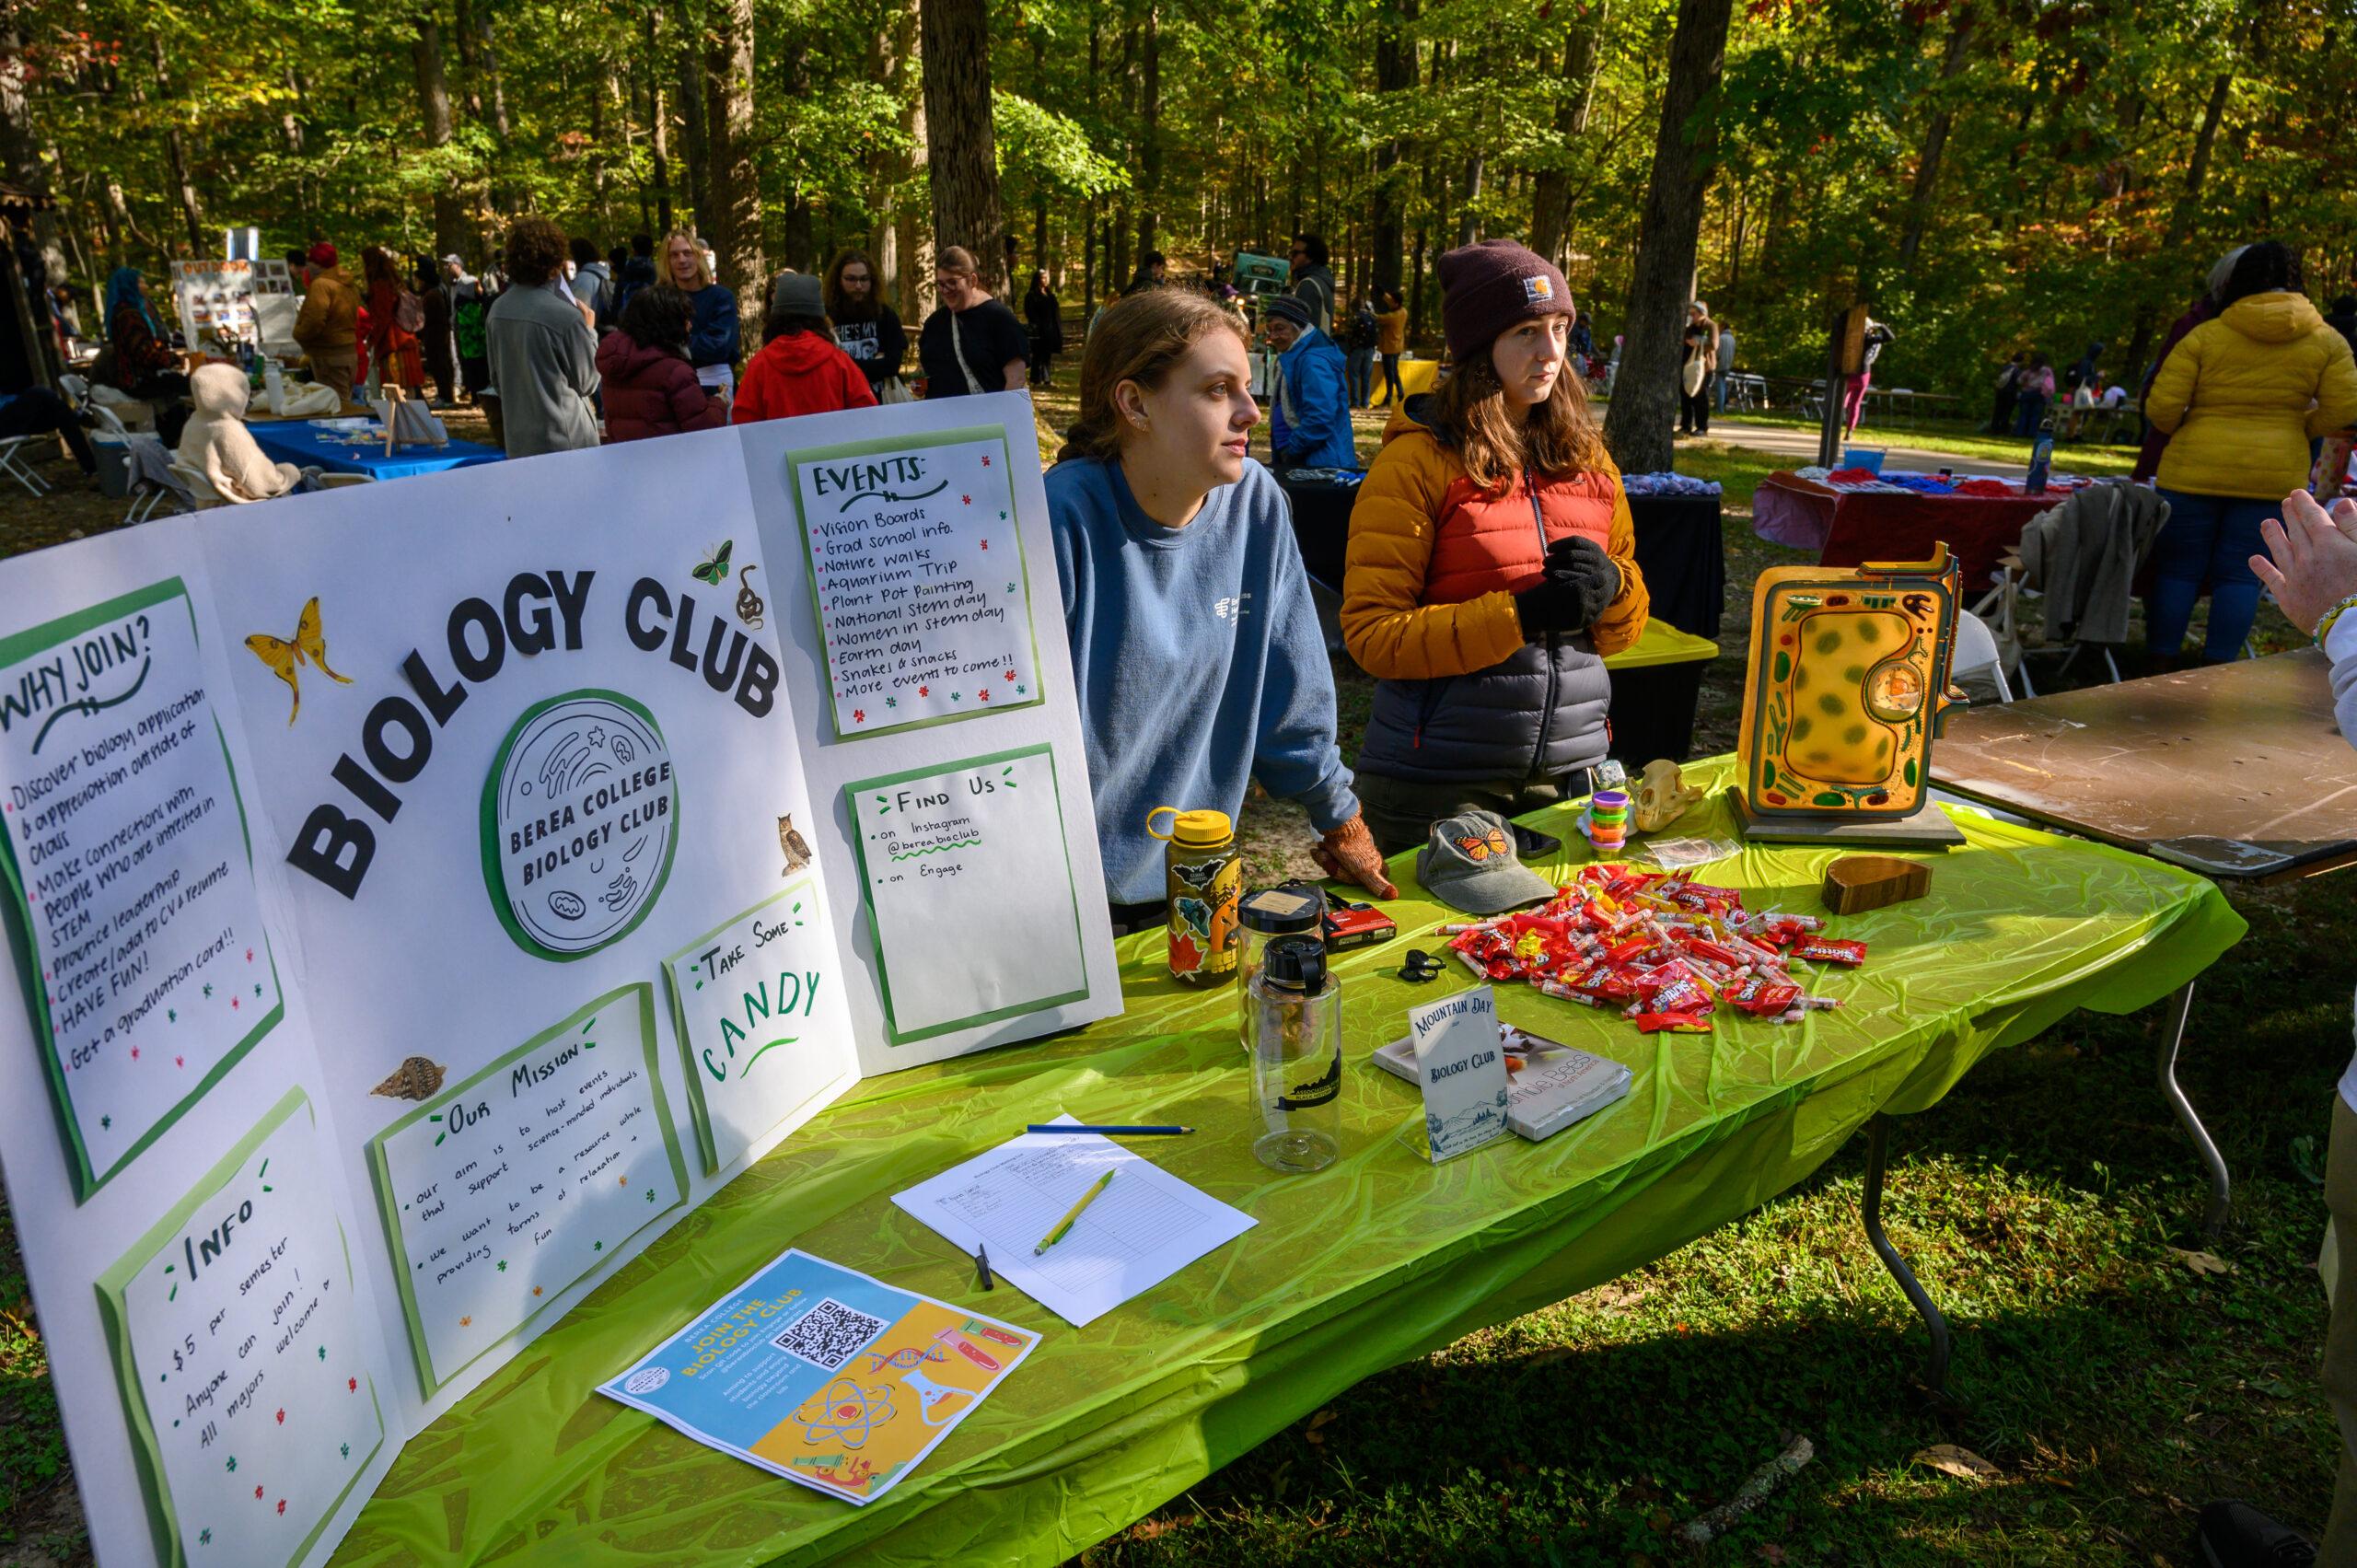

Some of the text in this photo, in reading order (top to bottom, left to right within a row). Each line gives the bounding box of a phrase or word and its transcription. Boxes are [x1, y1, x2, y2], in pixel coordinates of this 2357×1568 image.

[862, 321, 877, 338] MY
[820, 507, 925, 538] Vision Boards
[826, 522, 954, 556] Grad school info.
[825, 547, 932, 575] Nature walks
[828, 559, 958, 591] Aquarium Trip
[832, 593, 874, 611] Plant
[835, 606, 902, 629] National
[954, 592, 987, 609] day
[837, 625, 900, 646] Women
[903, 620, 919, 634] in
[972, 607, 1004, 623] day
[0, 615, 150, 733] WHY JOIN?
[839, 639, 922, 666] Earth day
[842, 662, 892, 684] Snakes
[845, 680, 883, 698] More
[893, 669, 940, 689] events
[944, 663, 959, 676] to
[11, 689, 205, 811] Discover biology application
[285, 570, 780, 900] BIOLOGY CLUB
[34, 766, 128, 834] appreciation
[132, 733, 179, 774] outside
[180, 719, 196, 739] of
[509, 761, 671, 854] BEREA COLLEGE
[880, 816, 970, 840] on Instagram
[29, 830, 71, 865] class
[37, 785, 194, 900] Make connections with
[43, 881, 93, 926] people
[97, 855, 130, 890] who
[133, 840, 153, 864] are
[201, 796, 215, 817] in
[522, 794, 669, 887] BIOLOGY CLUB
[145, 919, 157, 938] to
[159, 898, 176, 926] CV
[185, 861, 229, 905] resume
[889, 863, 964, 883] on Engage
[51, 909, 92, 948] STEM
[52, 869, 180, 979] practice leadership
[1805, 947, 1858, 961] Skittles
[60, 951, 149, 1034] HAVE FUN!
[70, 1041, 100, 1071] Get
[104, 1026, 116, 1043] a
[118, 962, 193, 1034] graduation
[1414, 997, 1492, 1039] MOUNTAIN DAY
[1651, 980, 1692, 1006] Skittles
[702, 971, 820, 1082] CANDY
[1431, 1061, 1469, 1084] BIOLOGY
[1471, 1051, 1496, 1070] CLUB
[1510, 1078, 1553, 1108] umble
[1542, 1054, 1591, 1082] Bees
[416, 1069, 610, 1206] our aim is to host events
[448, 1101, 491, 1135] OUR
[421, 1200, 446, 1223] that
[468, 1161, 509, 1197] support
[599, 1070, 638, 1101] individuals
[430, 1106, 642, 1261] we want to be a resource while
[183, 1200, 253, 1283] INFO
[436, 1245, 492, 1285] providing
[507, 1211, 540, 1236] forms
[557, 1189, 566, 1201] of
[579, 1150, 621, 1184] relaxation
[533, 1227, 552, 1246] fun
[208, 1307, 226, 1336] per
[238, 1237, 288, 1297] semester
[681, 1288, 803, 1376] BIOLOGY CLUB
[692, 1298, 766, 1353] JOIN THE
[185, 1369, 228, 1418] Anyone
[238, 1332, 257, 1360] can
[200, 1296, 319, 1450] All majors welcome
[698, 1363, 716, 1381] Scan
[726, 1347, 741, 1362] code
